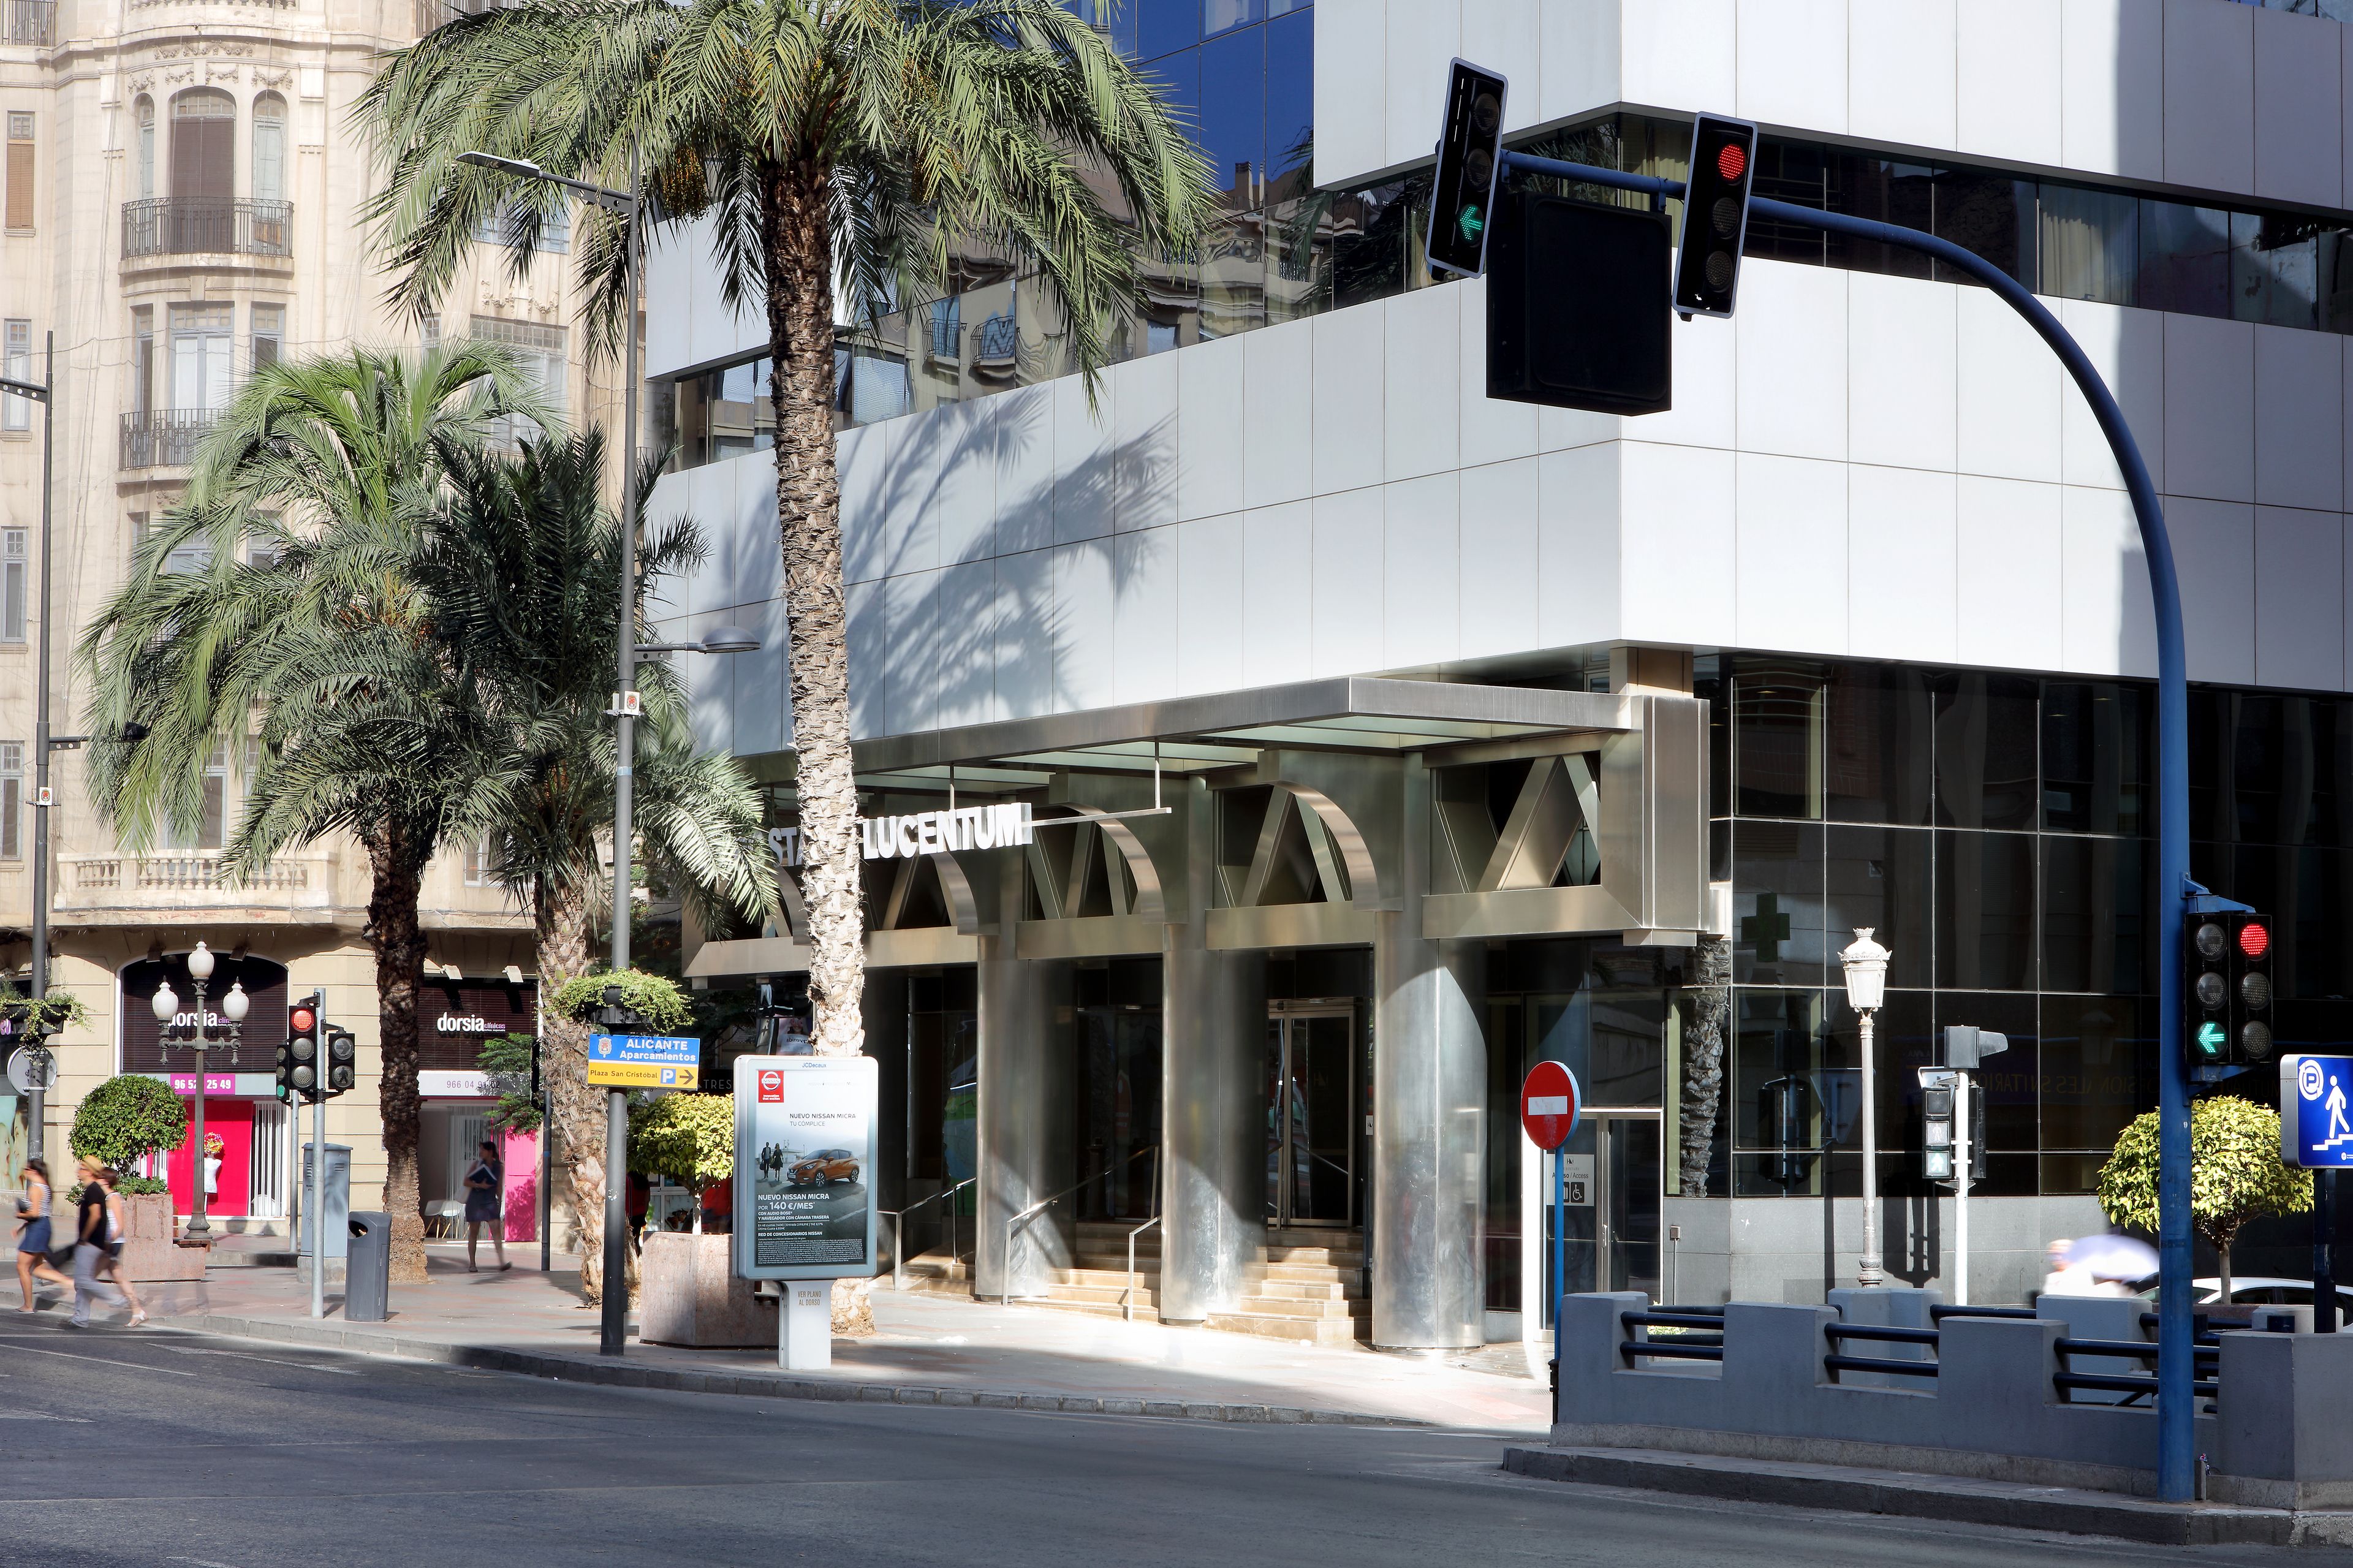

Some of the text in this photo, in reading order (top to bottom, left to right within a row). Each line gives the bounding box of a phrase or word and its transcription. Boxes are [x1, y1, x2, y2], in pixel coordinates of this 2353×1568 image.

[863, 802, 1033, 860] LUCENTUM
[437, 1011, 484, 1032] dorsia
[626, 1039, 688, 1050] ALICANTE
[620, 1050, 696, 1061] Aparcamientos
[662, 1069, 673, 1083] P
[175, 1079, 186, 1089] 96
[207, 1079, 218, 1089] 25
[219, 1079, 231, 1089] 49
